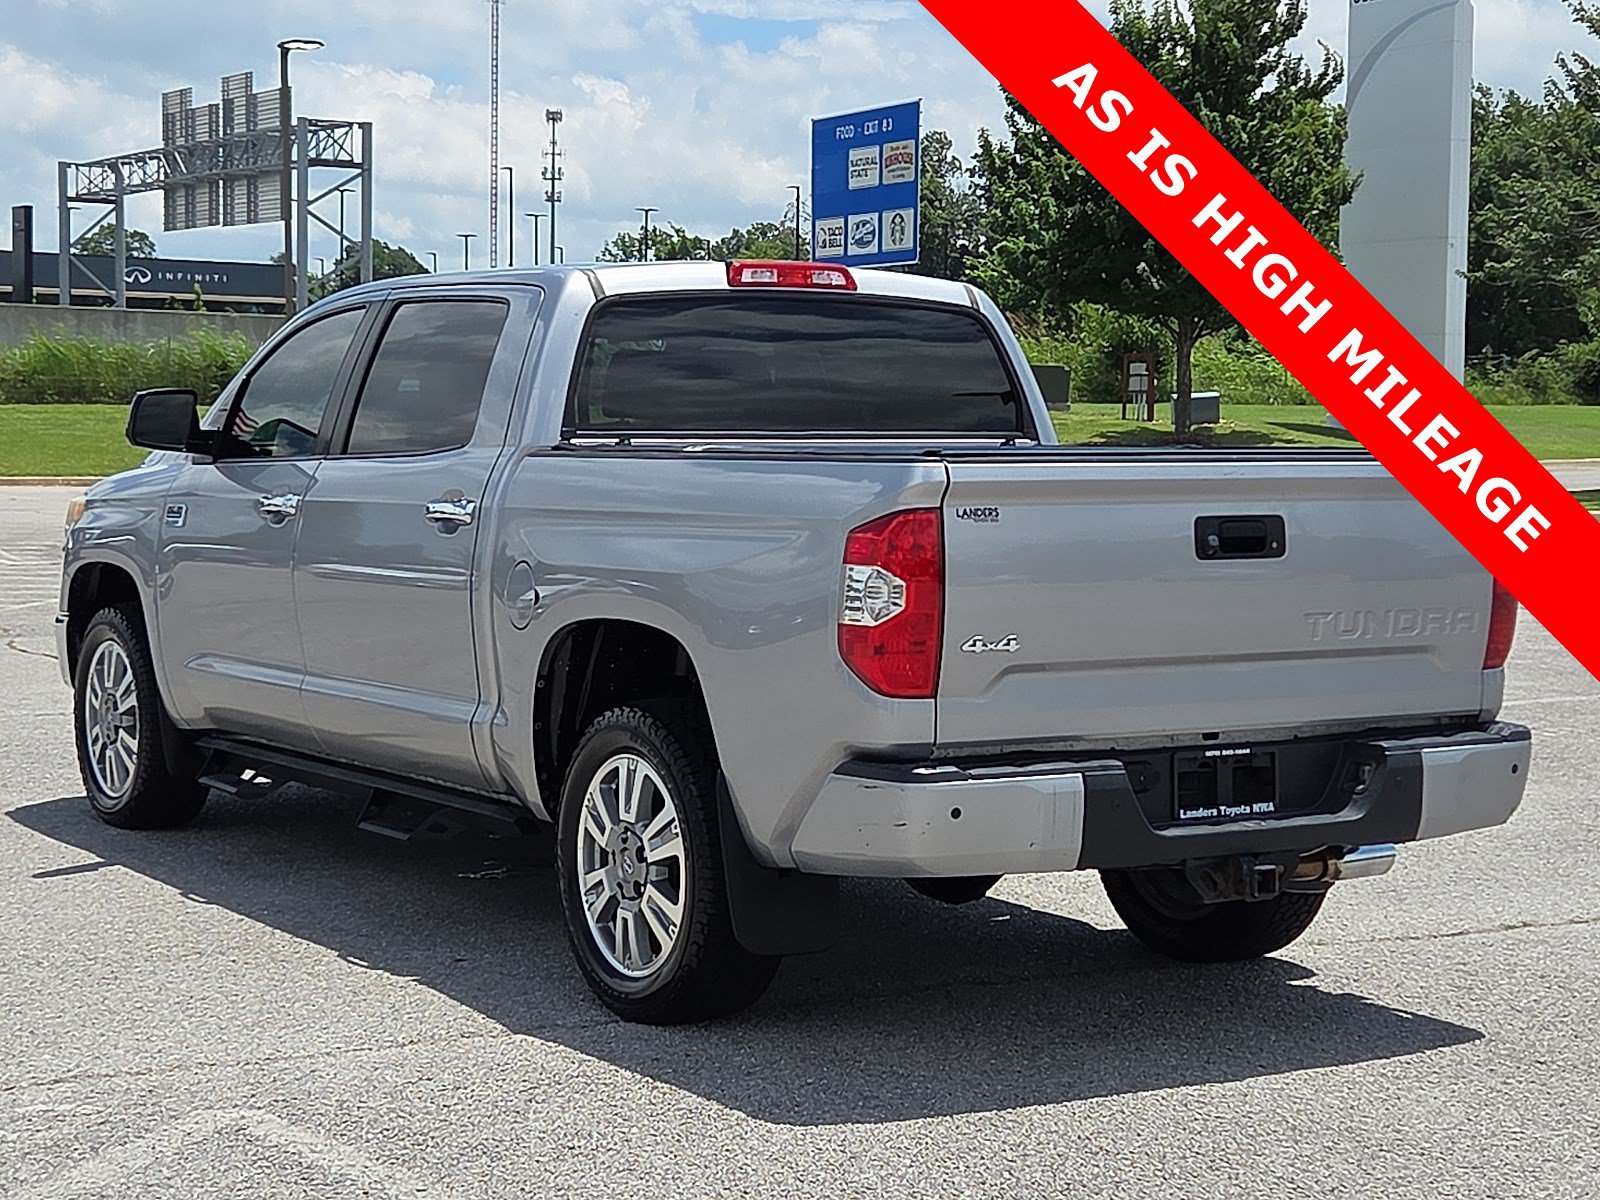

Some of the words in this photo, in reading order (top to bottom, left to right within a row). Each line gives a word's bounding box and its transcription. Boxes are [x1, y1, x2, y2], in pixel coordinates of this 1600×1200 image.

[836, 124, 855, 140] FOOD
[864, 119, 879, 135] EXIT
[882, 117, 893, 132] 83
[850, 156, 878, 168] NATURAL
[850, 167, 869, 179] STATE
[827, 225, 843, 237] TACO
[828, 236, 843, 249] BELL
[157, 272, 229, 284] INFINITI
[955, 507, 999, 519] LANDERS
[1303, 607, 1480, 641] TUNDRA
[1179, 806, 1218, 819] Landers
[1219, 805, 1251, 818] Toyota
